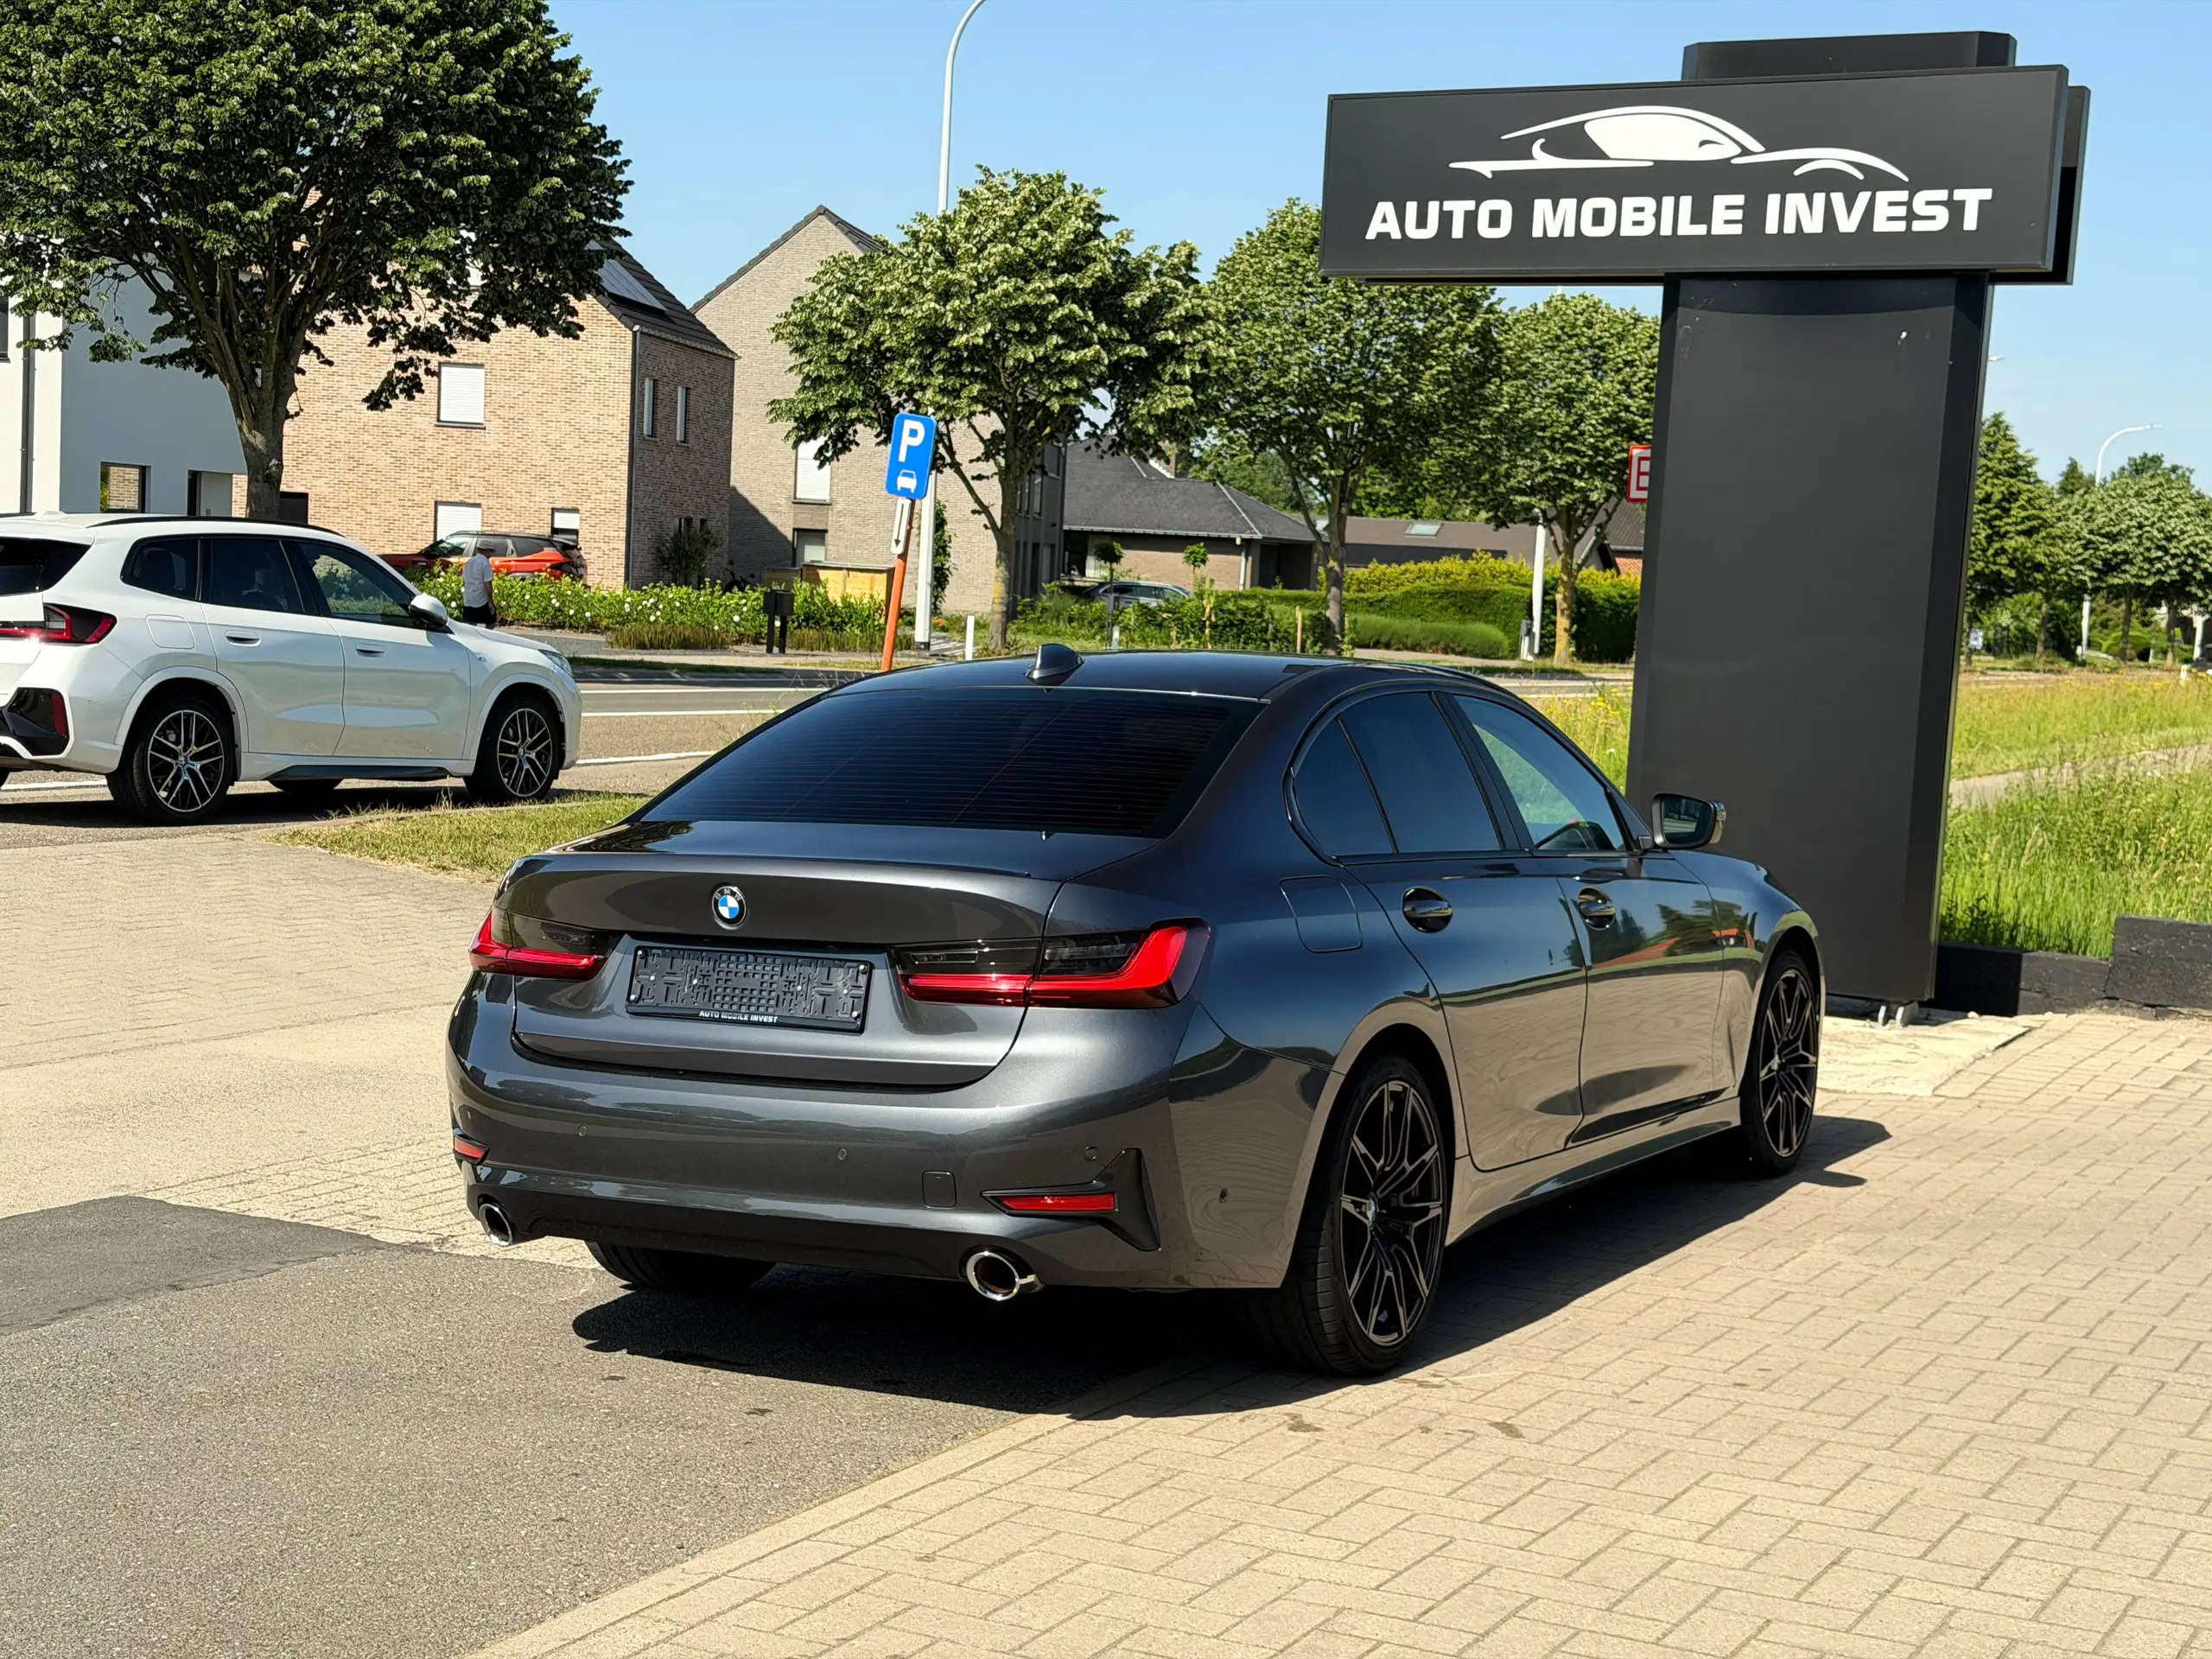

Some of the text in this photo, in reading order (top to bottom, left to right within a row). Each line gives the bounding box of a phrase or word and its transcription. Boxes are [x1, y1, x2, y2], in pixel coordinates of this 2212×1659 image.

[1364, 188, 1993, 241] AUTO MOBILE INVEST
[898, 419, 925, 462] P
[715, 888, 742, 901] BMW
[699, 1010, 779, 1023] AUTO MOBILE INVEST
